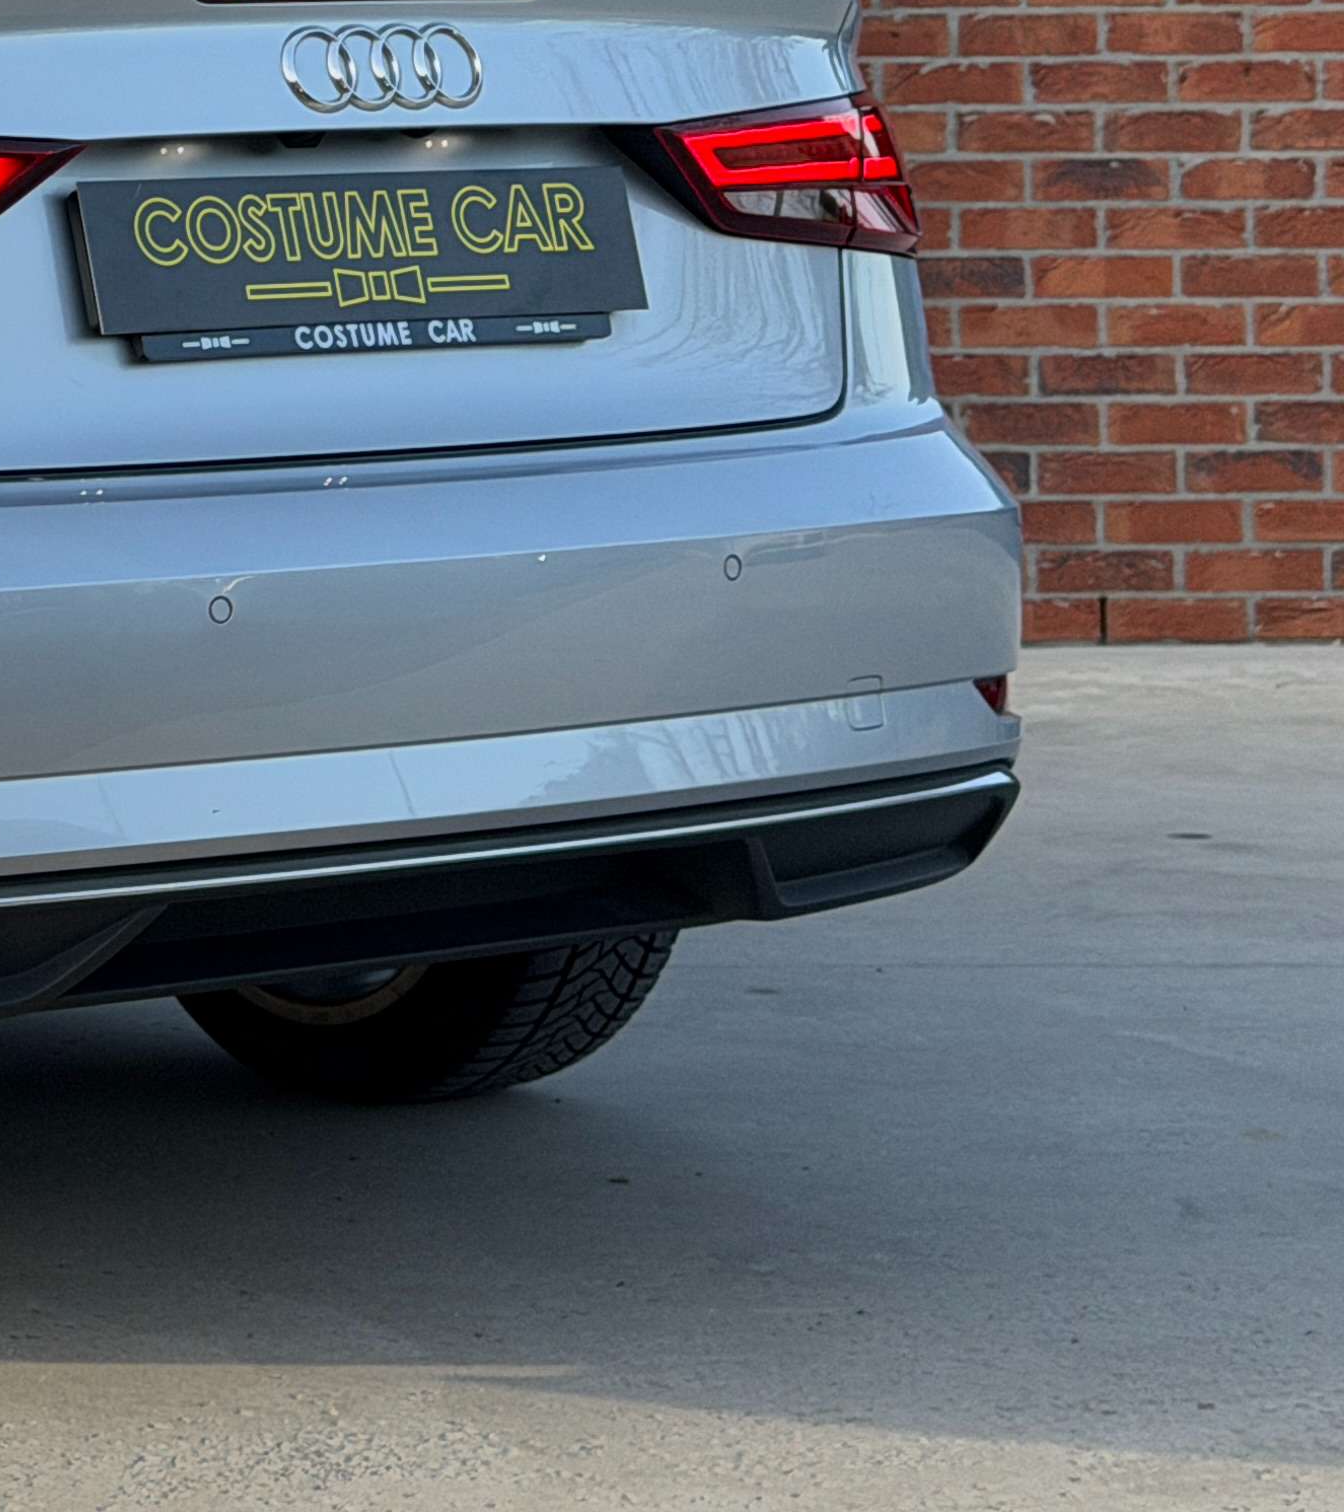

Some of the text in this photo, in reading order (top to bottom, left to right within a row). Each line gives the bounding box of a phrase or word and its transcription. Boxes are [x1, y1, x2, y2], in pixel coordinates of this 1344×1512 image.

[134, 182, 595, 266] COSTUME CAR
[294, 318, 477, 350] COSTUME CAR
